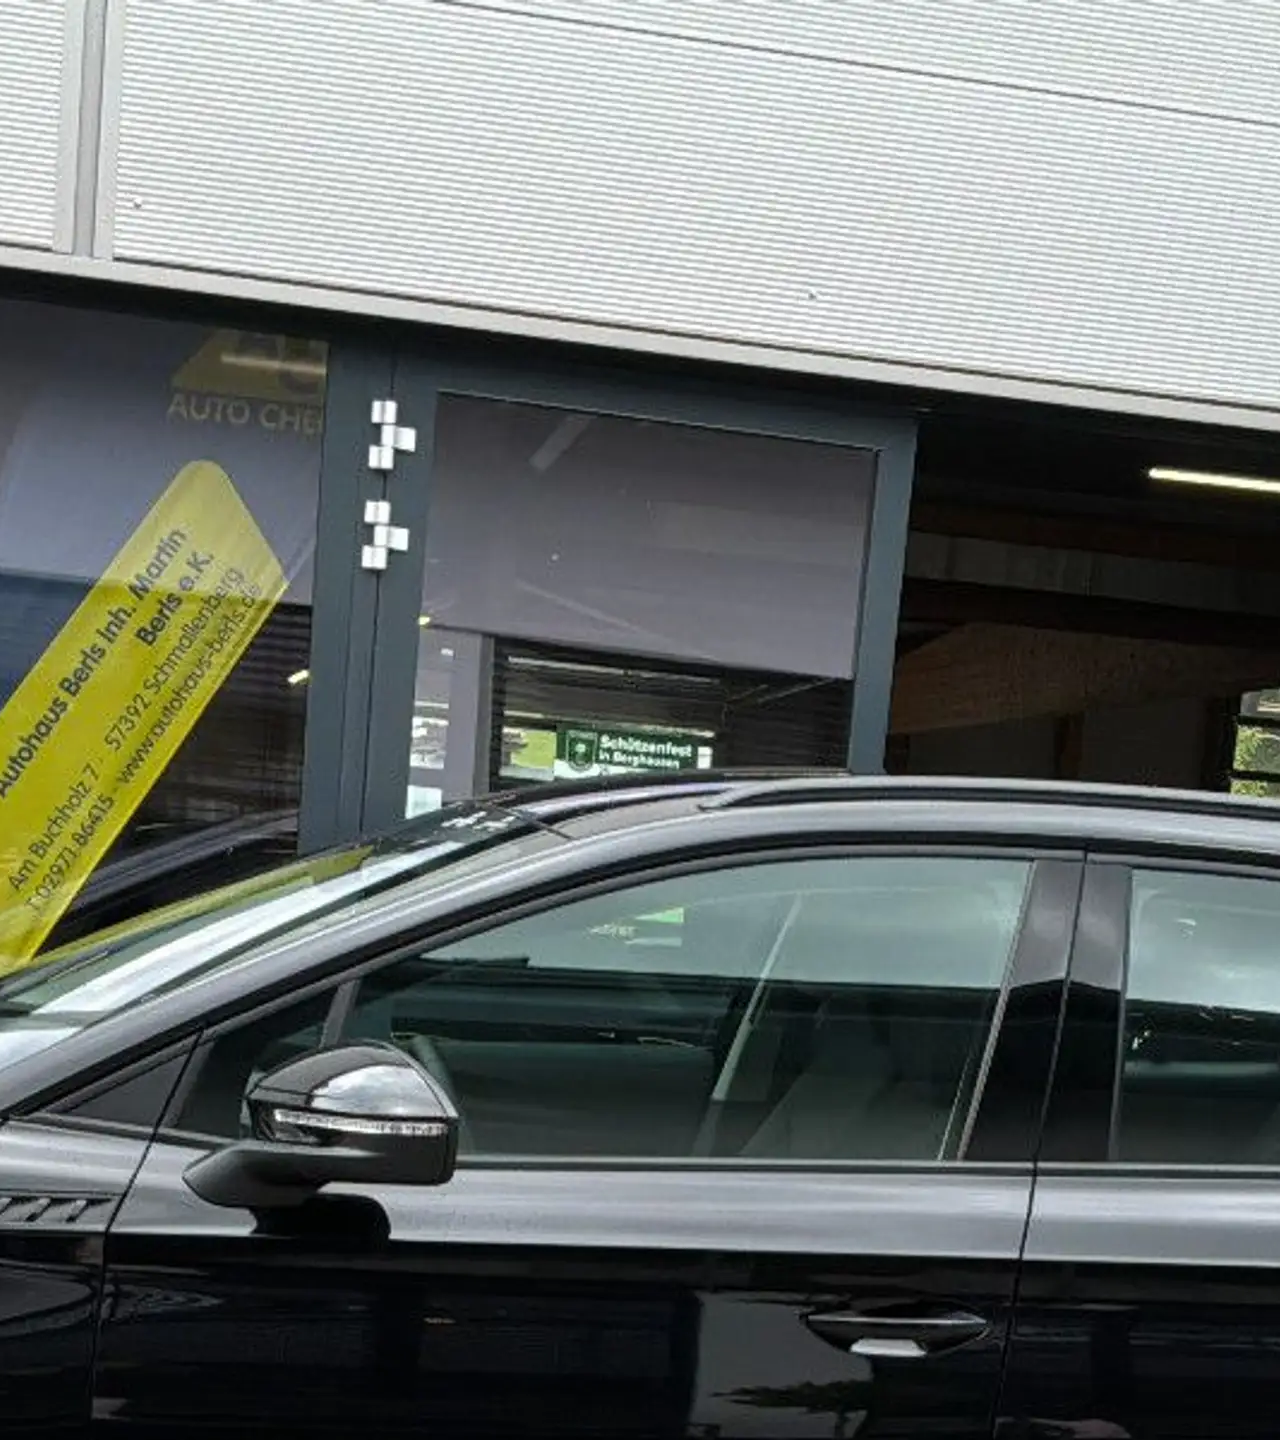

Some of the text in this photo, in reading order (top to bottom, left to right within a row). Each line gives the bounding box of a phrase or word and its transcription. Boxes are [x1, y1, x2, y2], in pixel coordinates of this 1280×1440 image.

[168, 393, 250, 424] AUTO
[59, 647, 106, 699] Berls
[97, 606, 137, 648] Inh.
[129, 527, 188, 601] Martin
[134, 552, 215, 647] Berls e.K.
[7, 567, 248, 892] Am Buchholz 7 57392 Schmallenberg
[600, 733, 693, 758] Schützenfest
[37, 843, 80, 902] 02971
